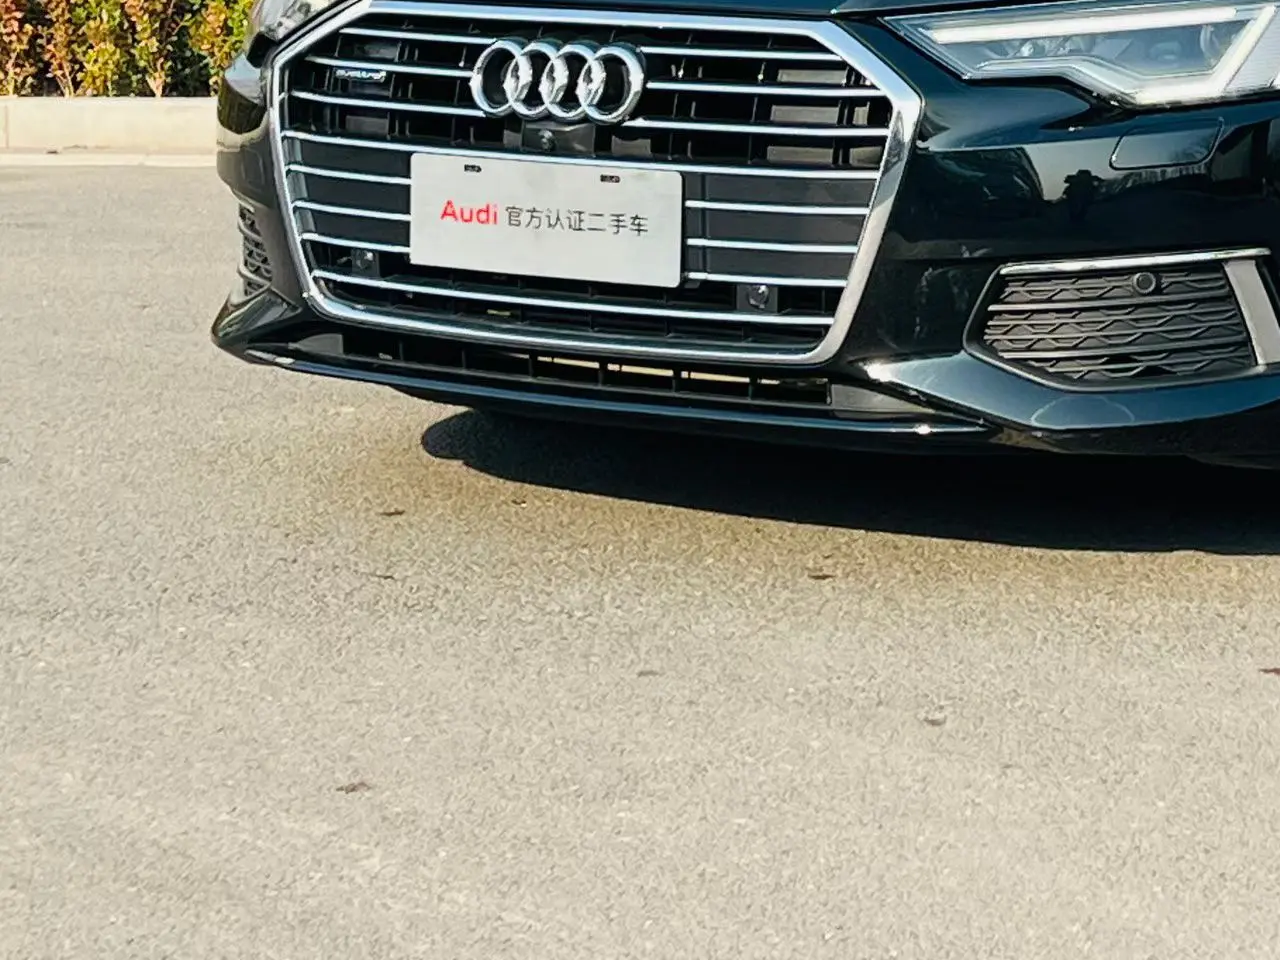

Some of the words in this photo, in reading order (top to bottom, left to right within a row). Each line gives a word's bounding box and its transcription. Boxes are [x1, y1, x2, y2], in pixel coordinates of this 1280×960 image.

[440, 200, 498, 225] Audi
[505, 205, 649, 236] 官方认证二手车
